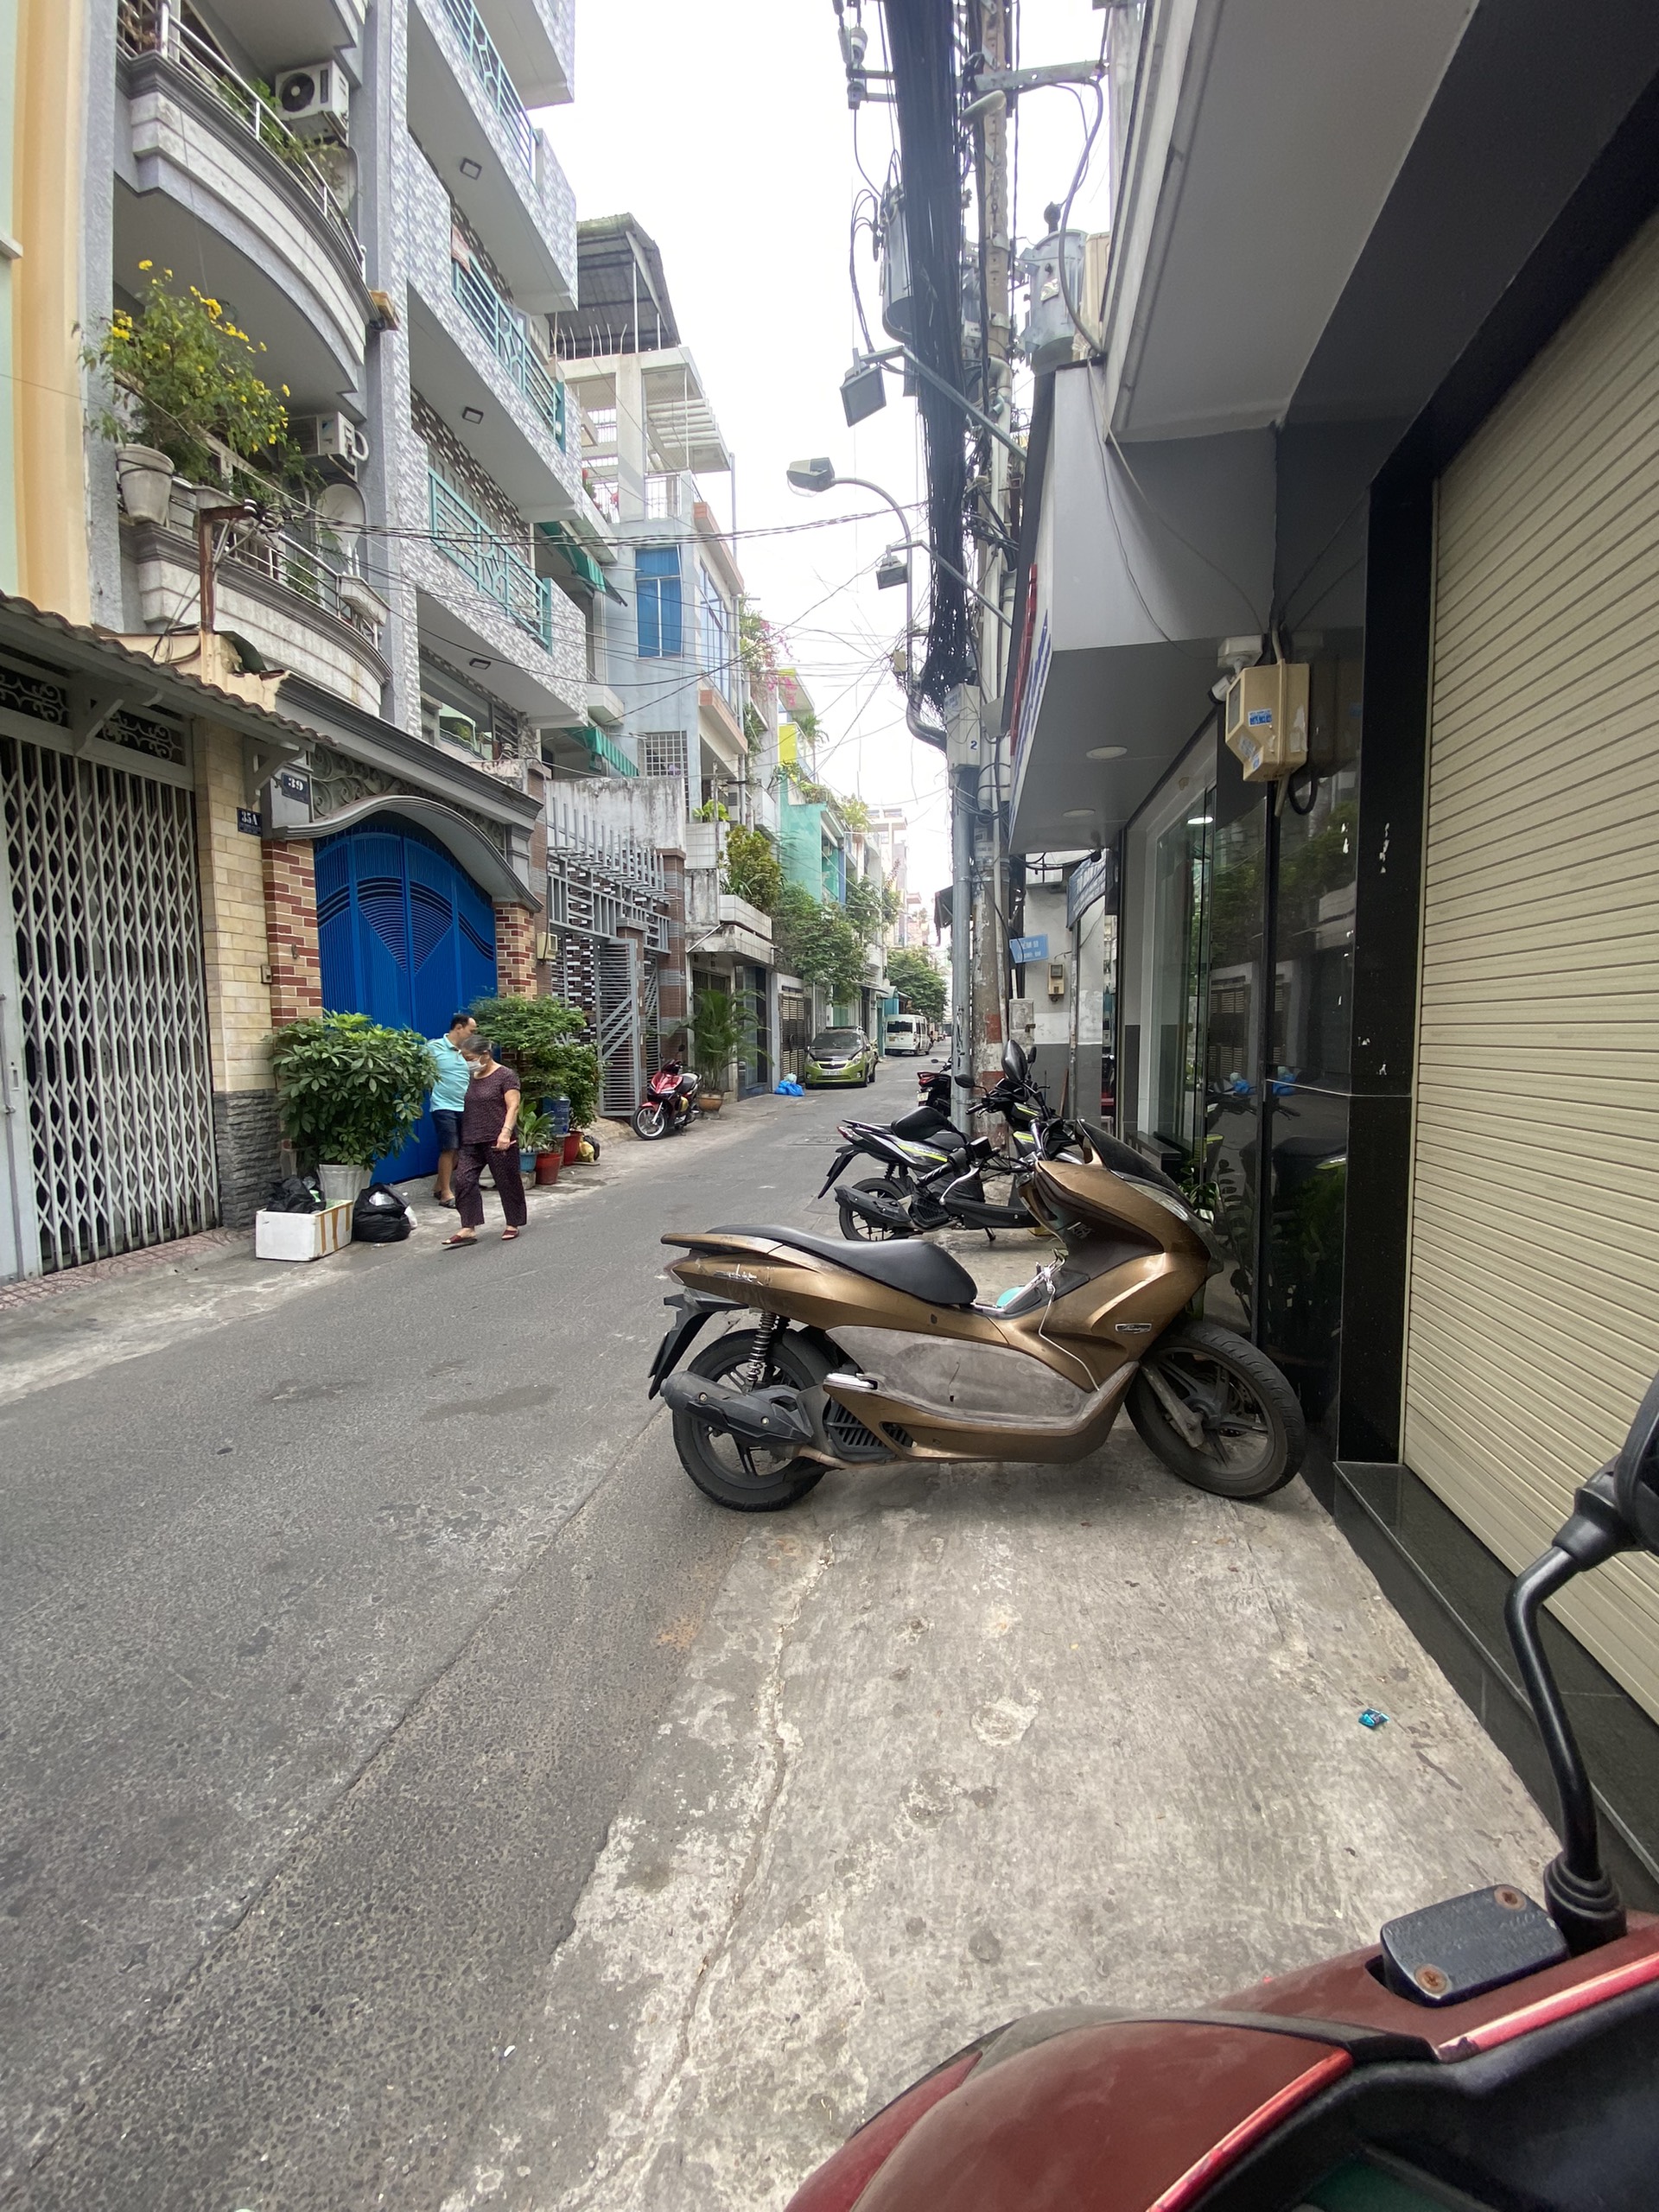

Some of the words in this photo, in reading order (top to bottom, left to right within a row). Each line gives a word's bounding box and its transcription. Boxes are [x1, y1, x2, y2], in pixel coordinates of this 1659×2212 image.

[970, 740, 978, 750] 2
[288, 777, 304, 791] 39
[241, 810, 258, 826] 35A
